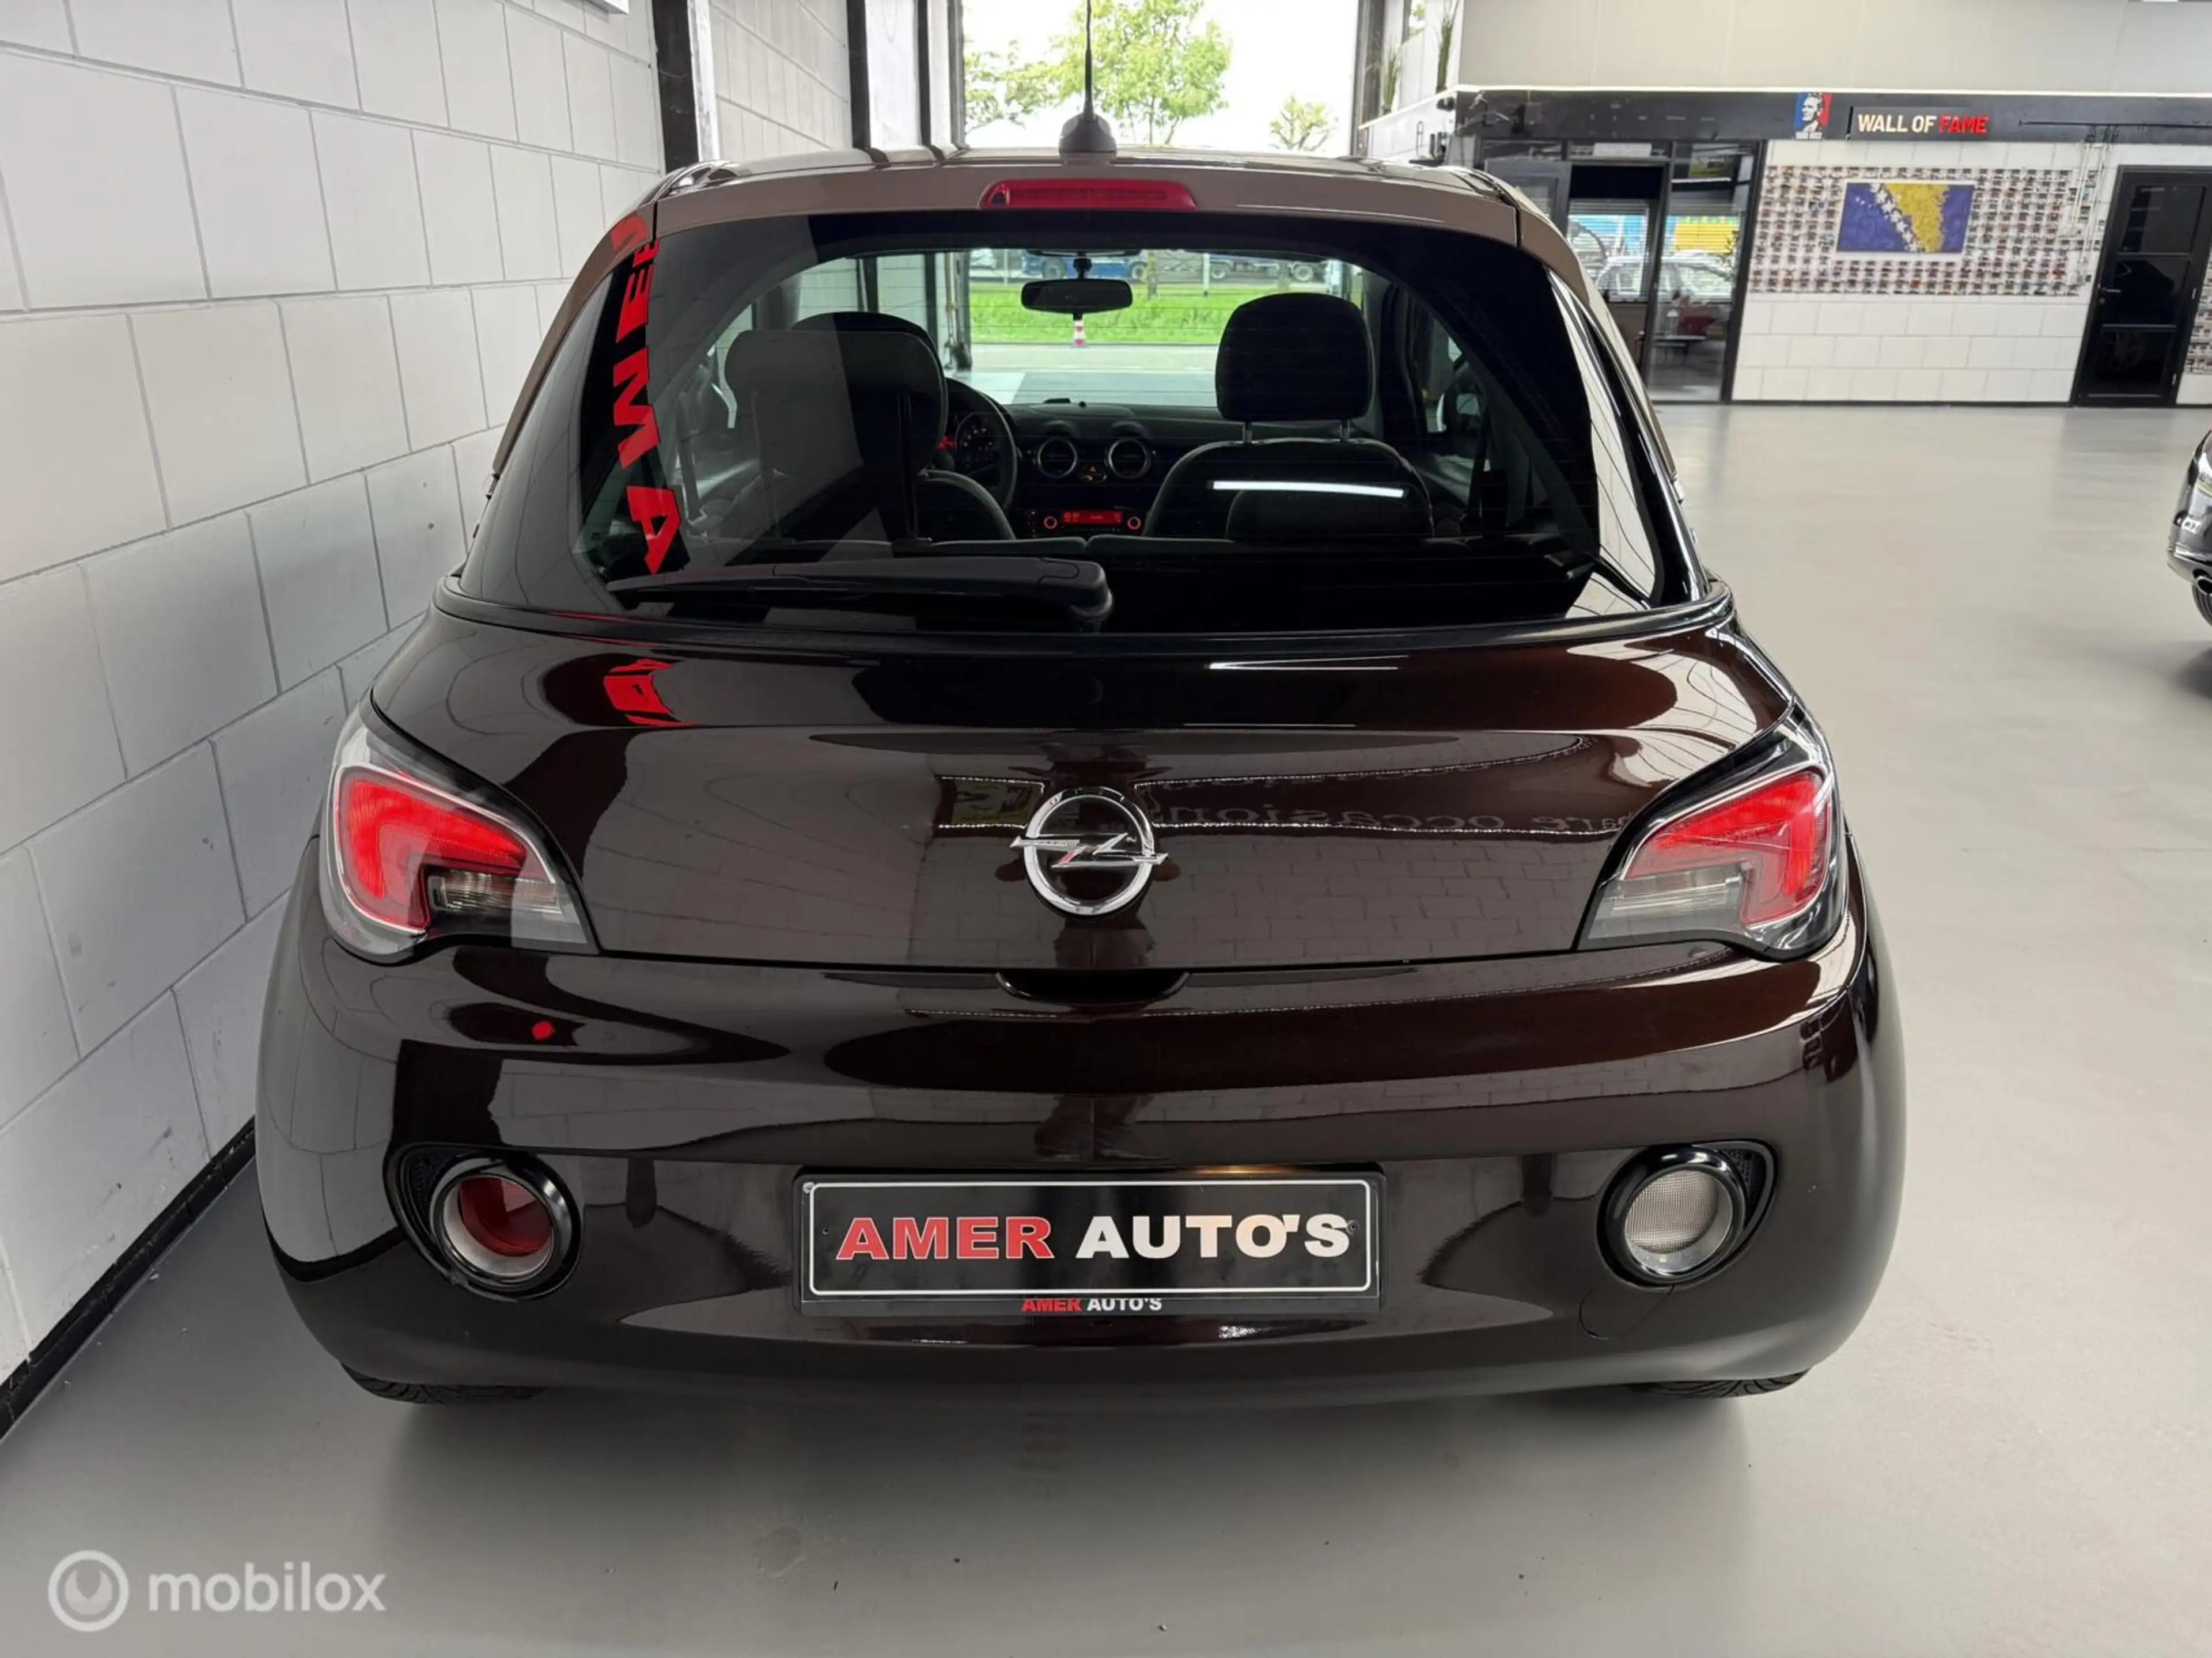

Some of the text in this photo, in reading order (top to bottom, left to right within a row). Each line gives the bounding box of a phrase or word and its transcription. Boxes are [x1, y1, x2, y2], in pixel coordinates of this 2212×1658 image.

[1858, 115, 1990, 134] WALL OF FAME
[835, 1213, 1350, 1260] AMER AUTO'S
[1021, 1297, 1162, 1311] AMER AUTO'S
